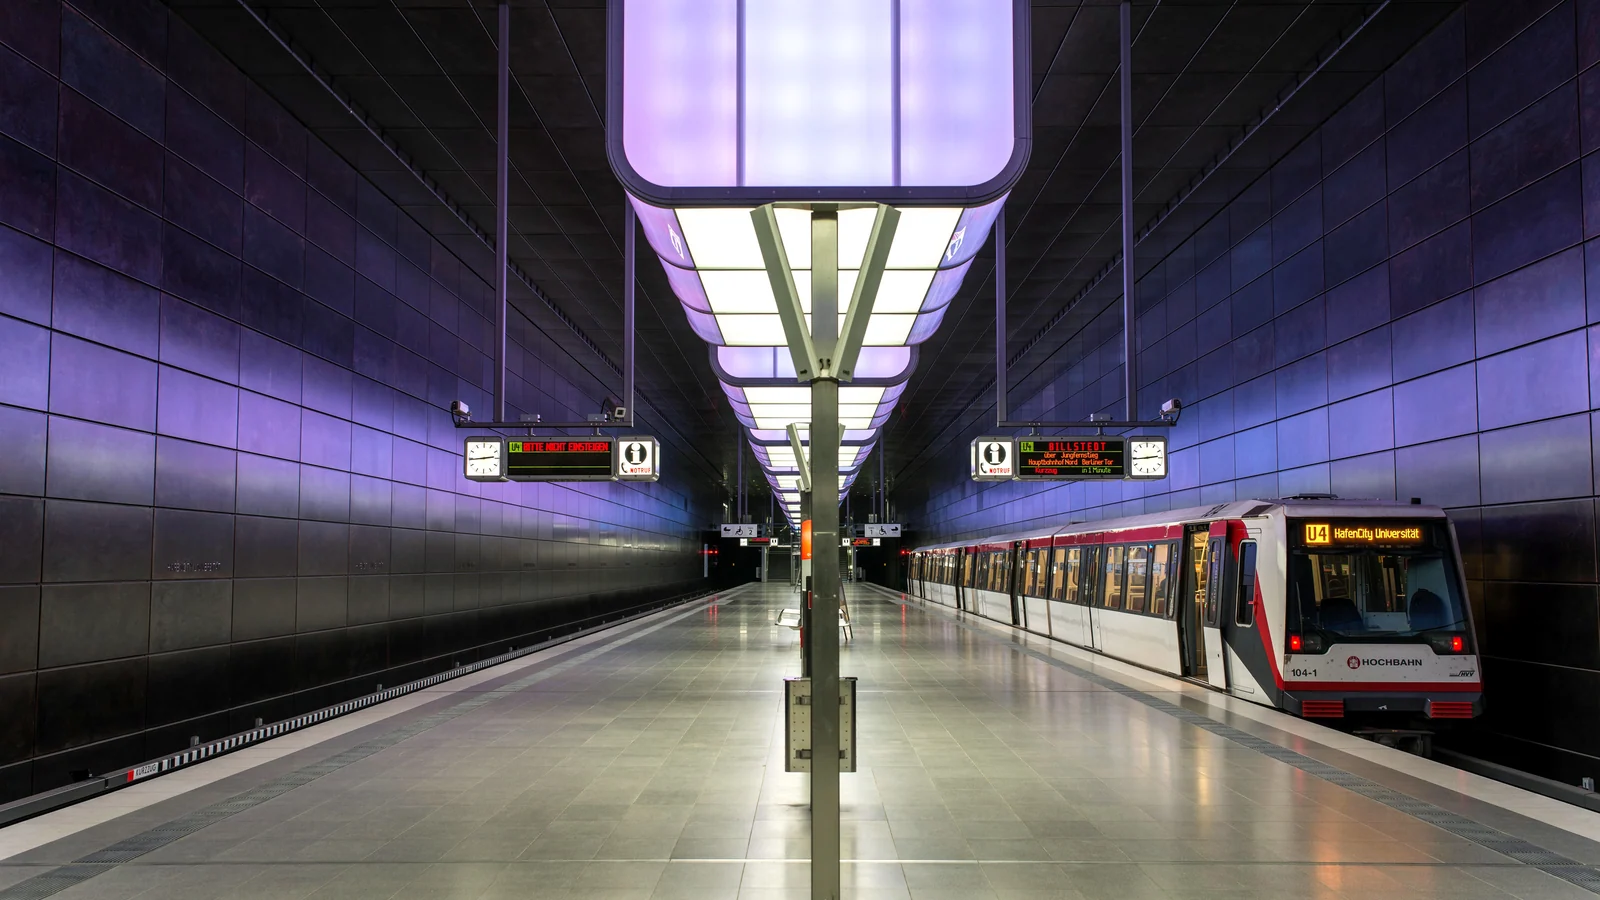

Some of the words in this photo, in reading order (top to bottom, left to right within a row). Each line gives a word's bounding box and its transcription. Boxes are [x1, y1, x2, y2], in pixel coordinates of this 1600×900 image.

[523, 442, 544, 451] BITTE
[545, 442, 566, 451] NICHT
[567, 442, 609, 451] EINSTEIGEN
[1048, 442, 1107, 451] BILLSTEDT
[1060, 452, 1099, 460] Jungfernstieg
[1035, 467, 1058, 475] Kurzzug
[1308, 526, 1328, 541] U4
[1334, 528, 1373, 540] HafenCity
[1375, 528, 1420, 539] Universität
[1362, 658, 1423, 667] HOCHBAHN
[1291, 668, 1318, 677] 104-1
[135, 763, 157, 776] KURZZUG
